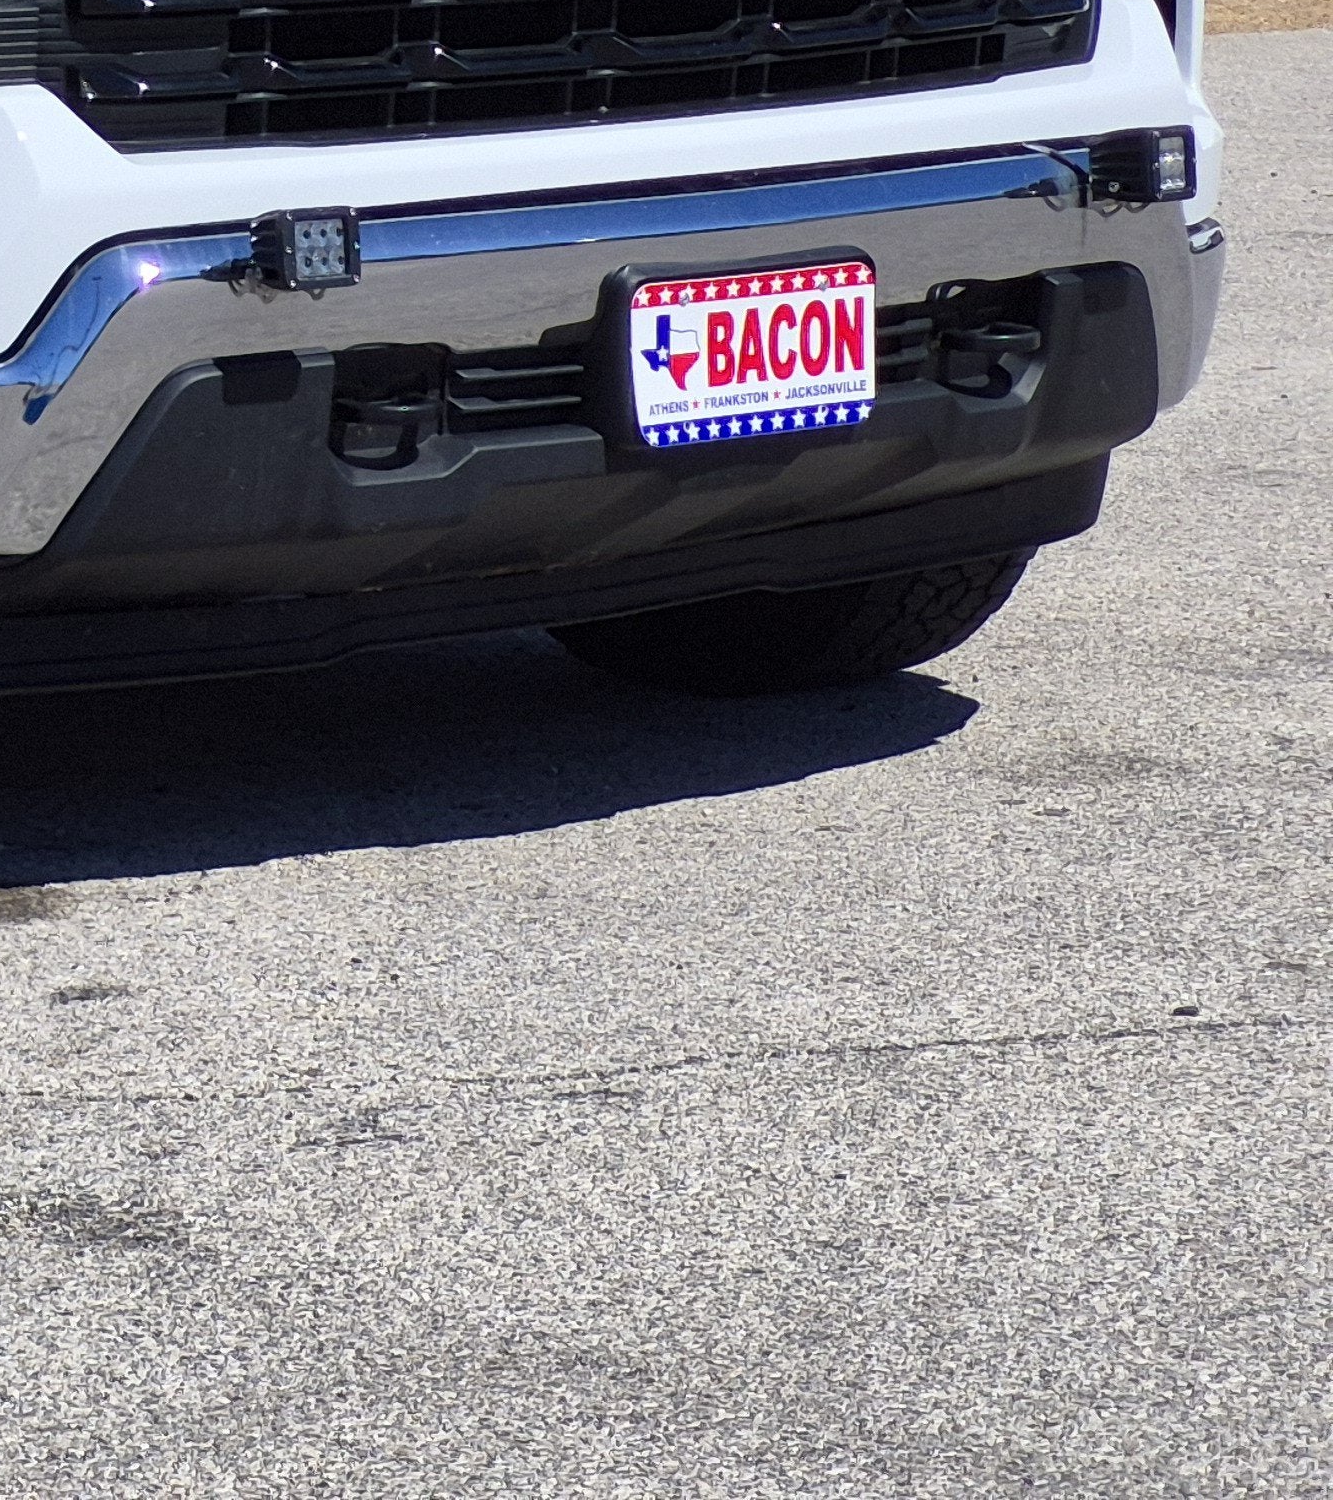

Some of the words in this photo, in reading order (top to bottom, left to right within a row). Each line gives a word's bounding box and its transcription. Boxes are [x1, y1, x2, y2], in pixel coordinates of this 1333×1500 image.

[707, 296, 865, 388] BACON
[648, 399, 690, 417] ATHENS
[703, 390, 769, 409] FRANKSTON
[784, 379, 867, 401] JACKSONVILLE
